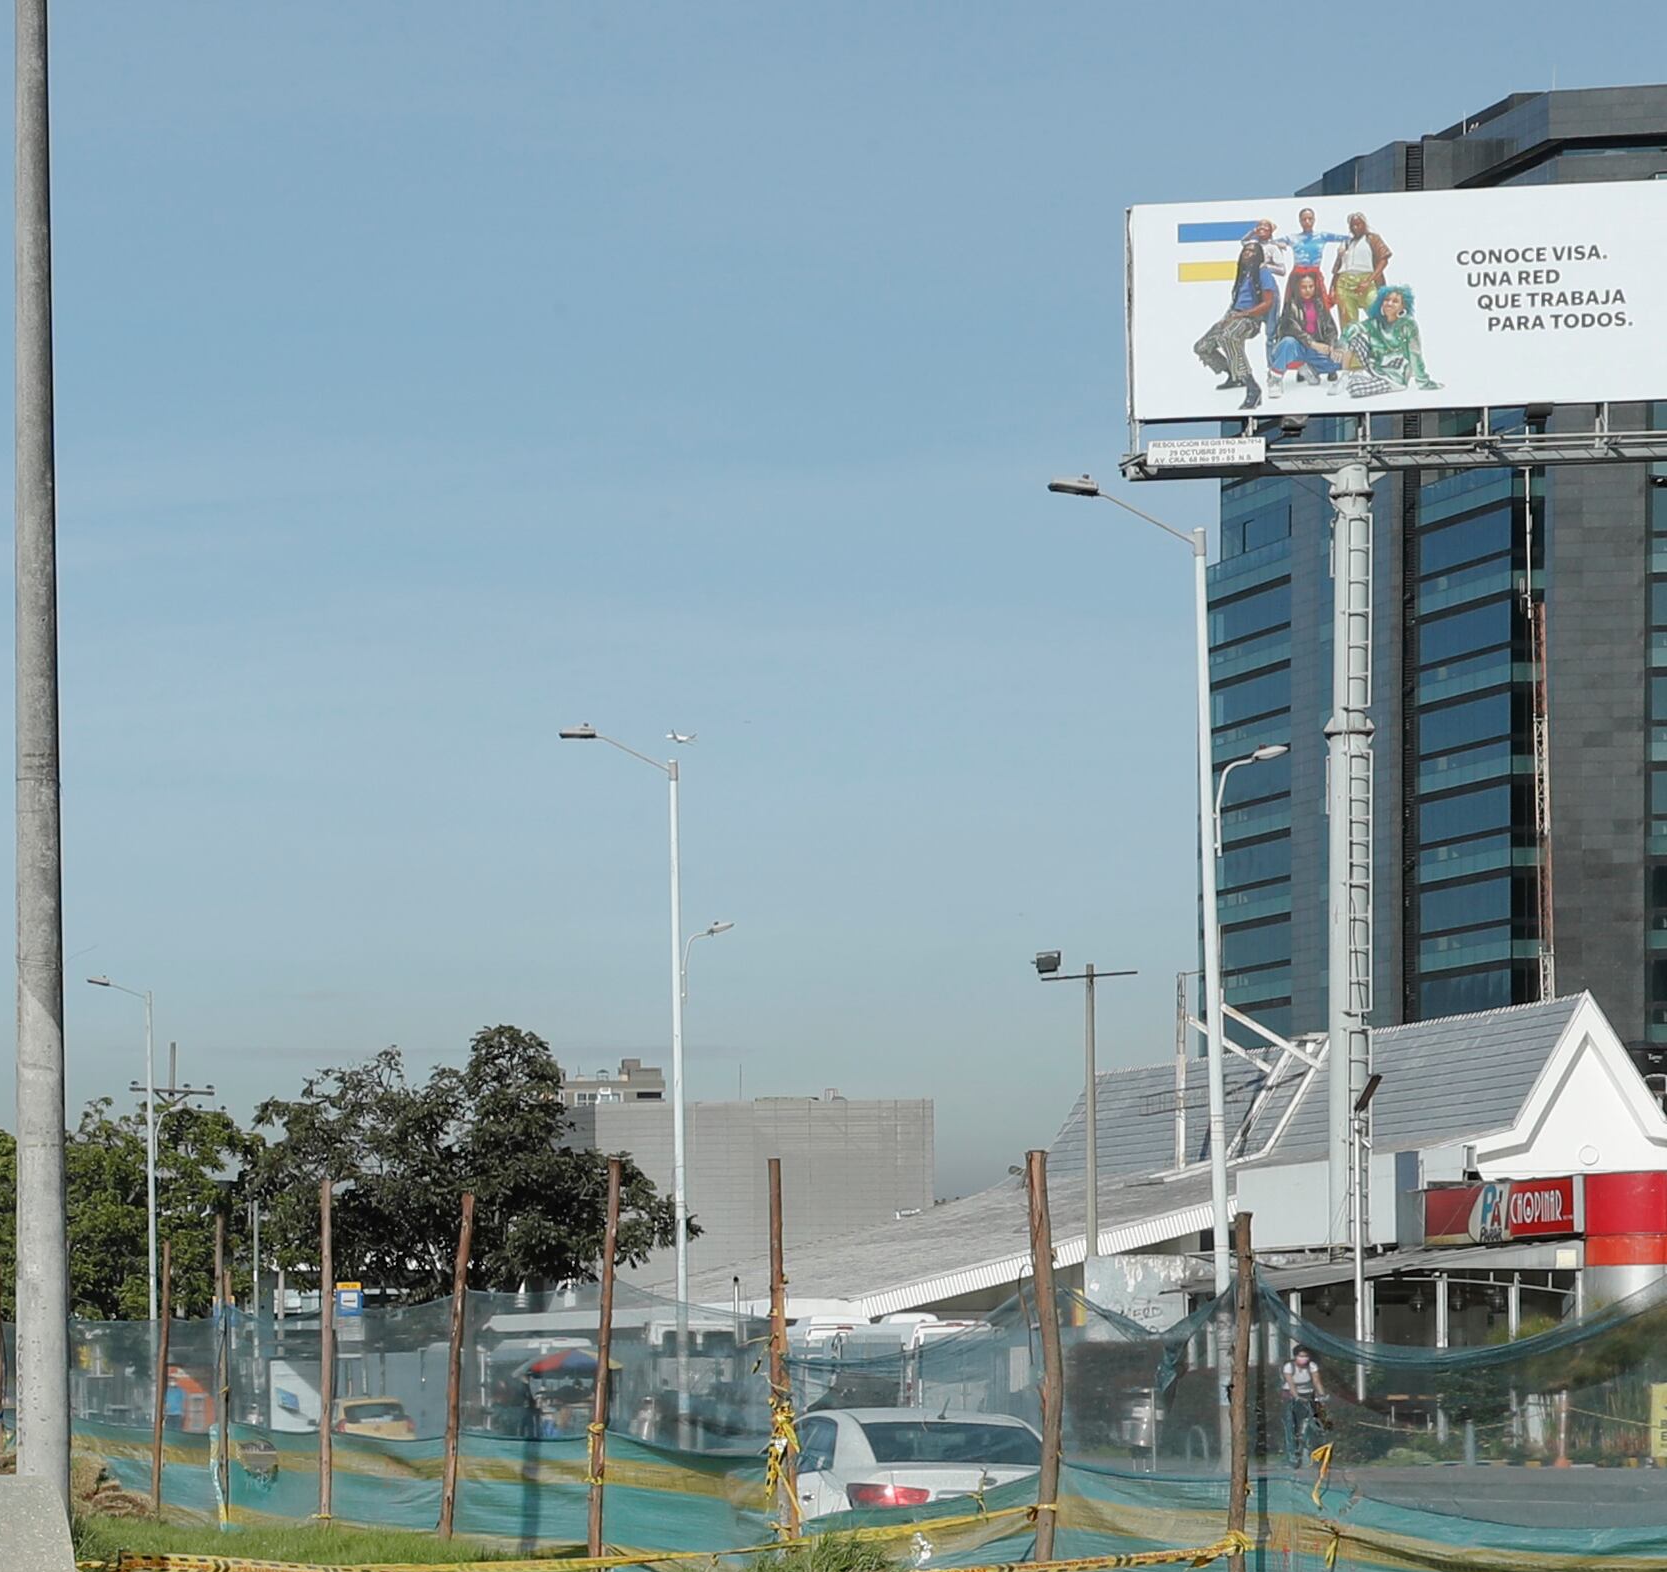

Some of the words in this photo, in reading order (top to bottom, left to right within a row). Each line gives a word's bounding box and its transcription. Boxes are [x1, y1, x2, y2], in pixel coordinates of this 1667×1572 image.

[1456, 247, 1547, 265] CONOCE
[1552, 244, 1608, 262] VISA.
[1467, 270, 1513, 287] UNA
[1517, 269, 1560, 285] RED
[1477, 293, 1522, 311] QUE
[1526, 289, 1626, 308] TRABAJA
[1488, 315, 1545, 332] PARA
[1550, 311, 1633, 330] TODOS.
[1510, 1189, 1563, 1224] CHOPINAR
